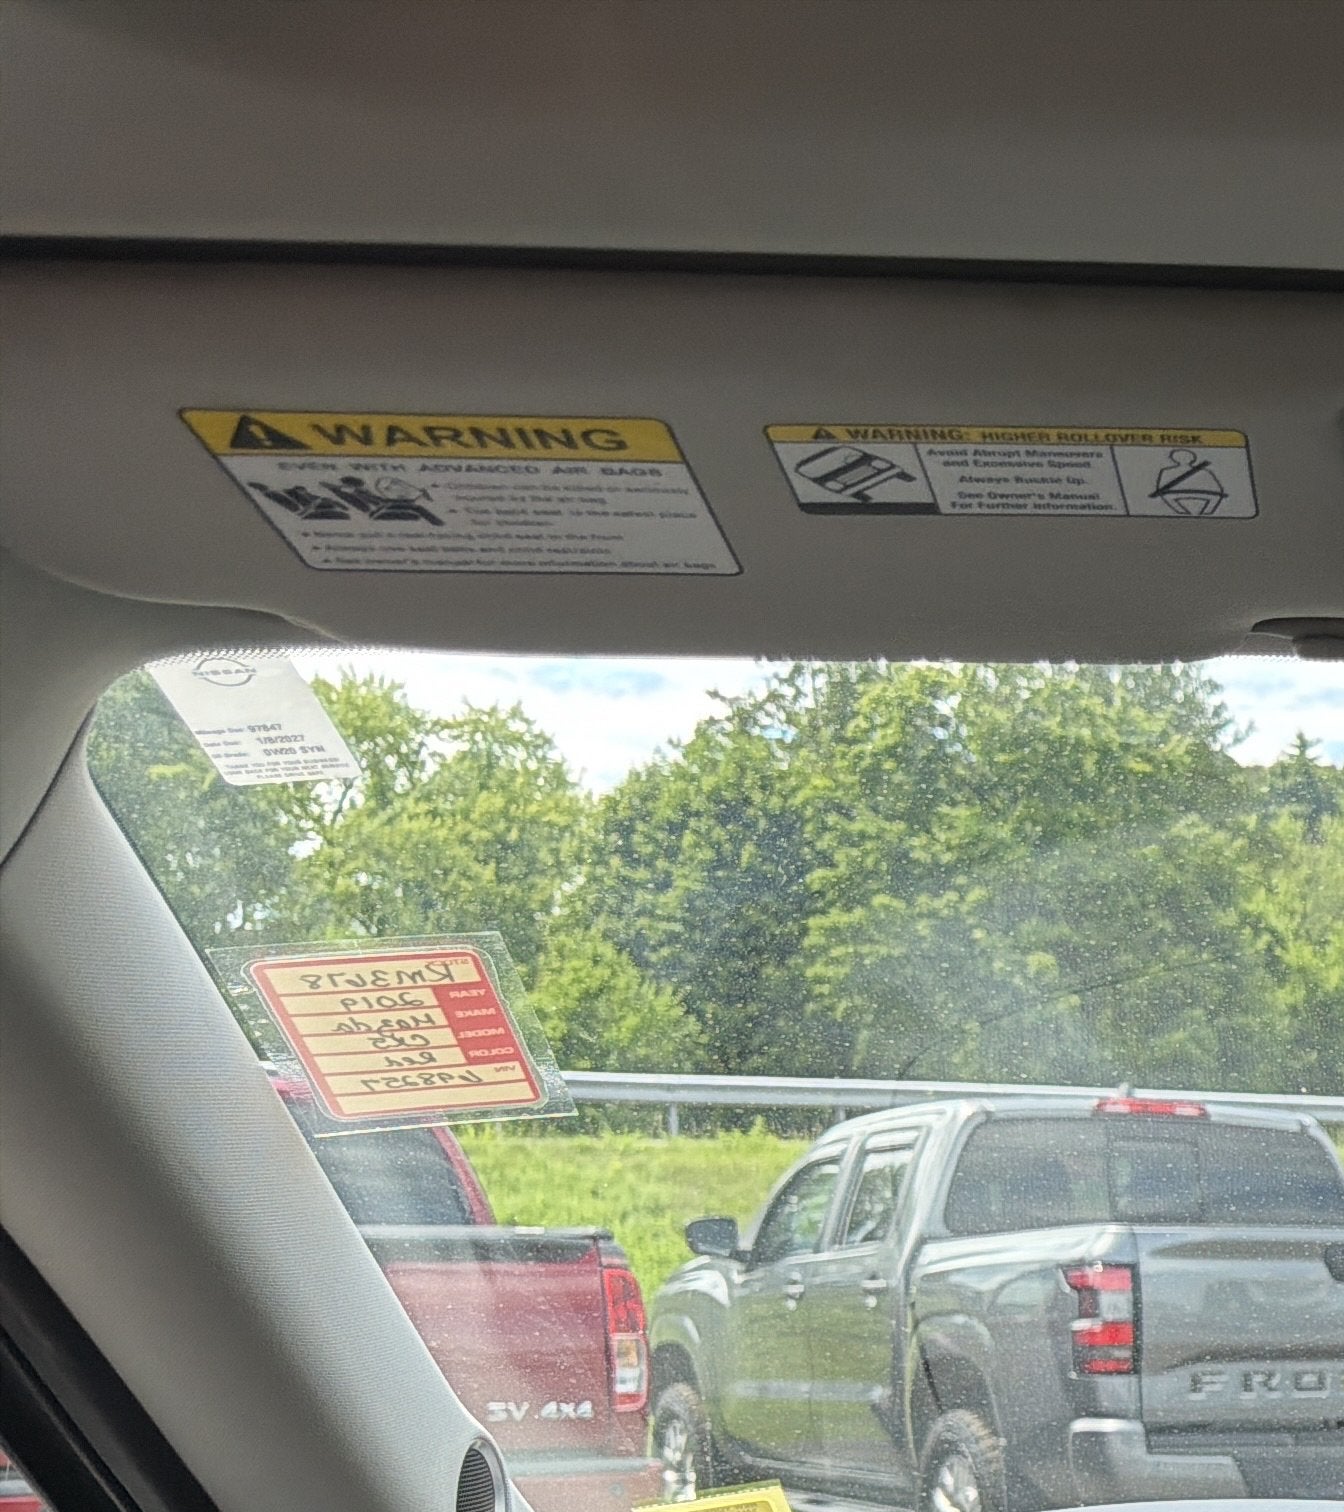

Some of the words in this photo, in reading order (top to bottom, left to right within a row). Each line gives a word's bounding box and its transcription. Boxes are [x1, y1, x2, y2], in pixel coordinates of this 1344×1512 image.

[312, 423, 629, 451] WARNING
[847, 428, 969, 441] WARNING:
[981, 432, 1051, 443] HIGHER
[1057, 432, 1154, 444] ROLLOVER
[1160, 435, 1203, 445] RISK
[301, 745, 326, 754] SYN
[487, 1401, 530, 1422] SV
